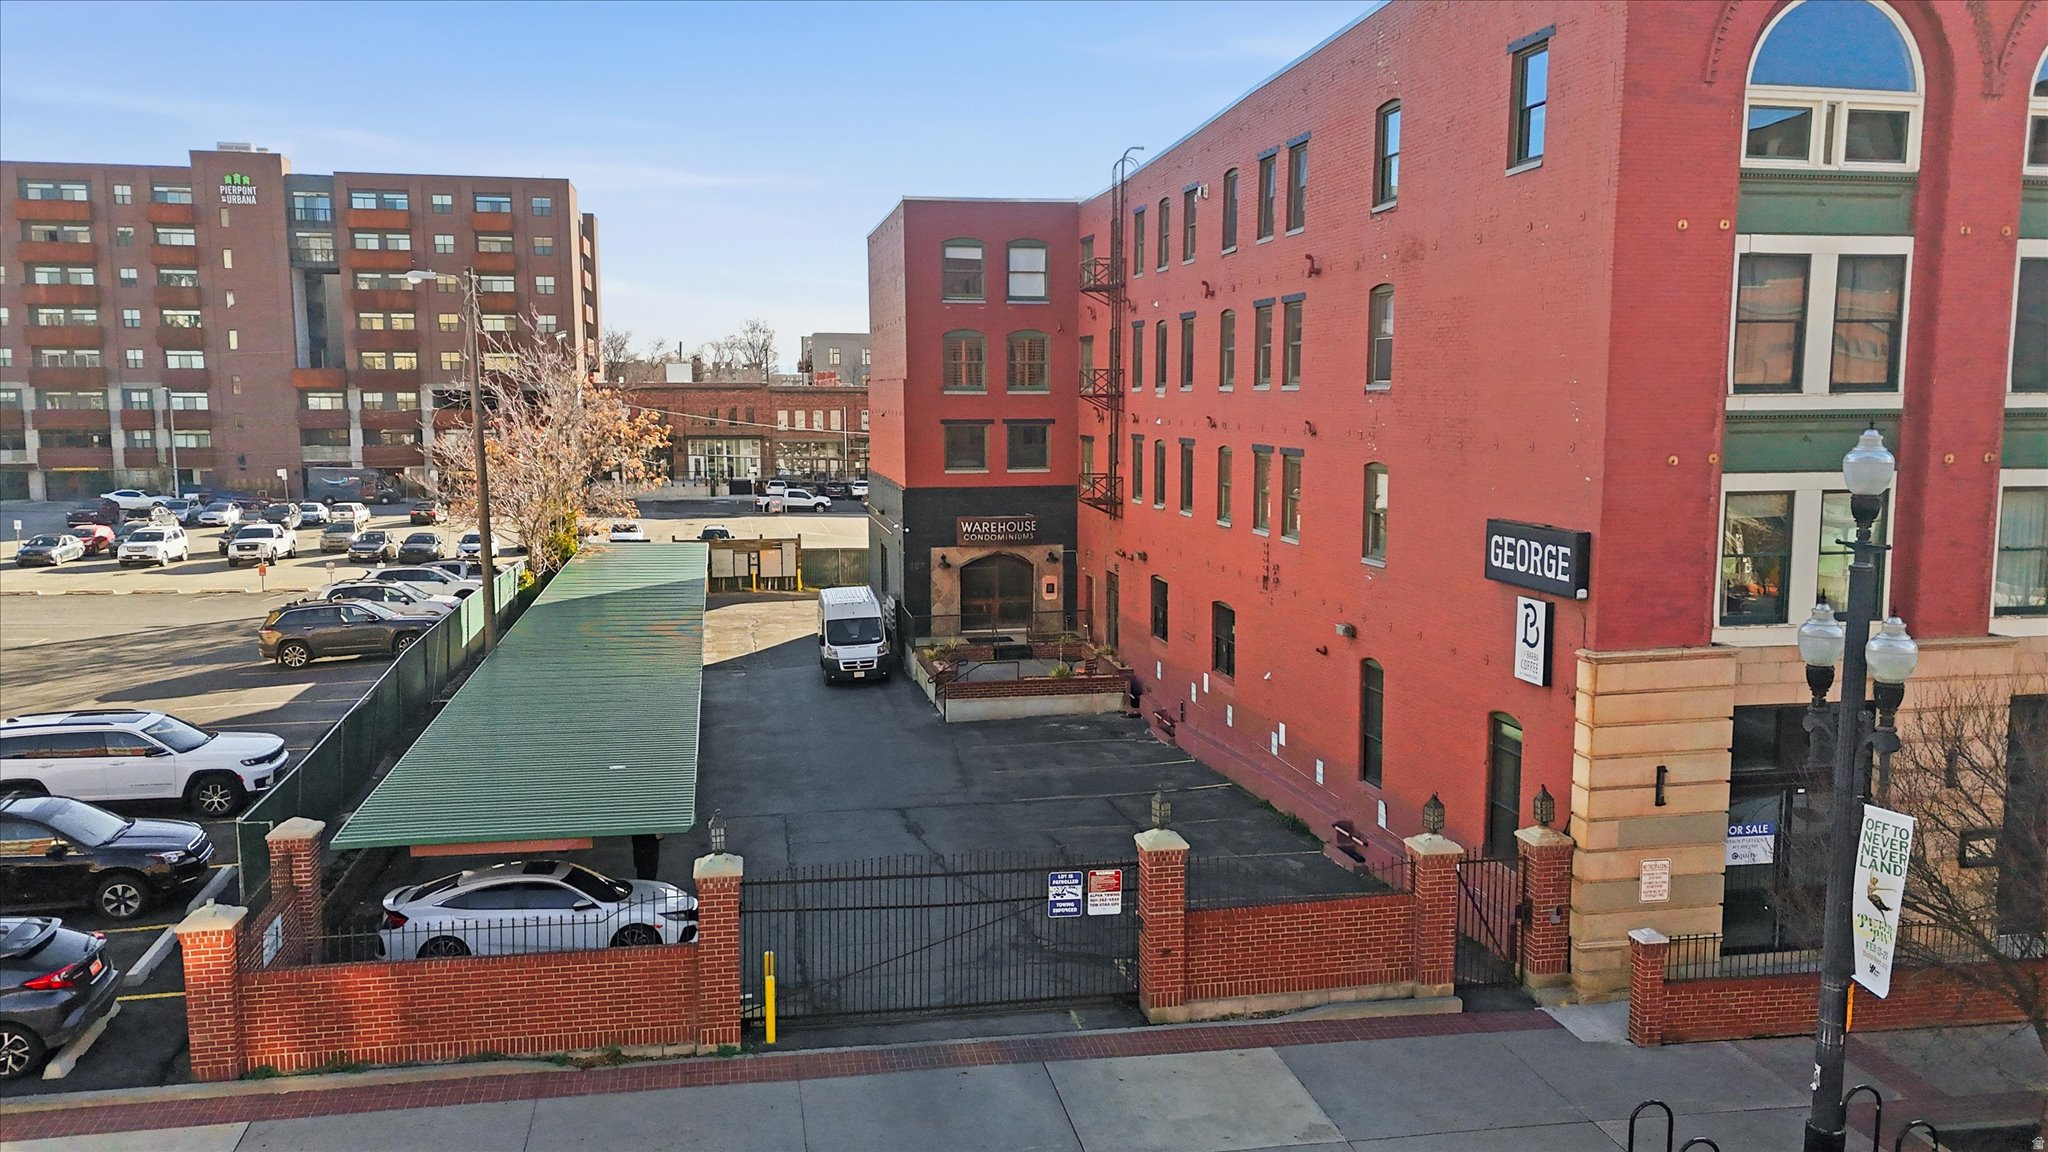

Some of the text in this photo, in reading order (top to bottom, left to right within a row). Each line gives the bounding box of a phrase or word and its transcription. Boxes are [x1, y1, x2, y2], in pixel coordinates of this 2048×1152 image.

[220, 185, 257, 195] PIERPONT
[226, 195, 257, 205] URBANA
[960, 520, 1037, 533] WAREHOUSE
[963, 532, 1034, 541] CONDOMINIUMS
[1490, 534, 1571, 583] GEORGE
[1520, 658, 1539, 675] COFFEE
[1728, 824, 1769, 835] OR SALE
[1865, 818, 1910, 841] OFF TO
[1863, 830, 1909, 854] NEVER
[1861, 842, 1908, 867] NEVER
[1860, 854, 1906, 880] LAND!
[1865, 941, 1877, 953] FEB
